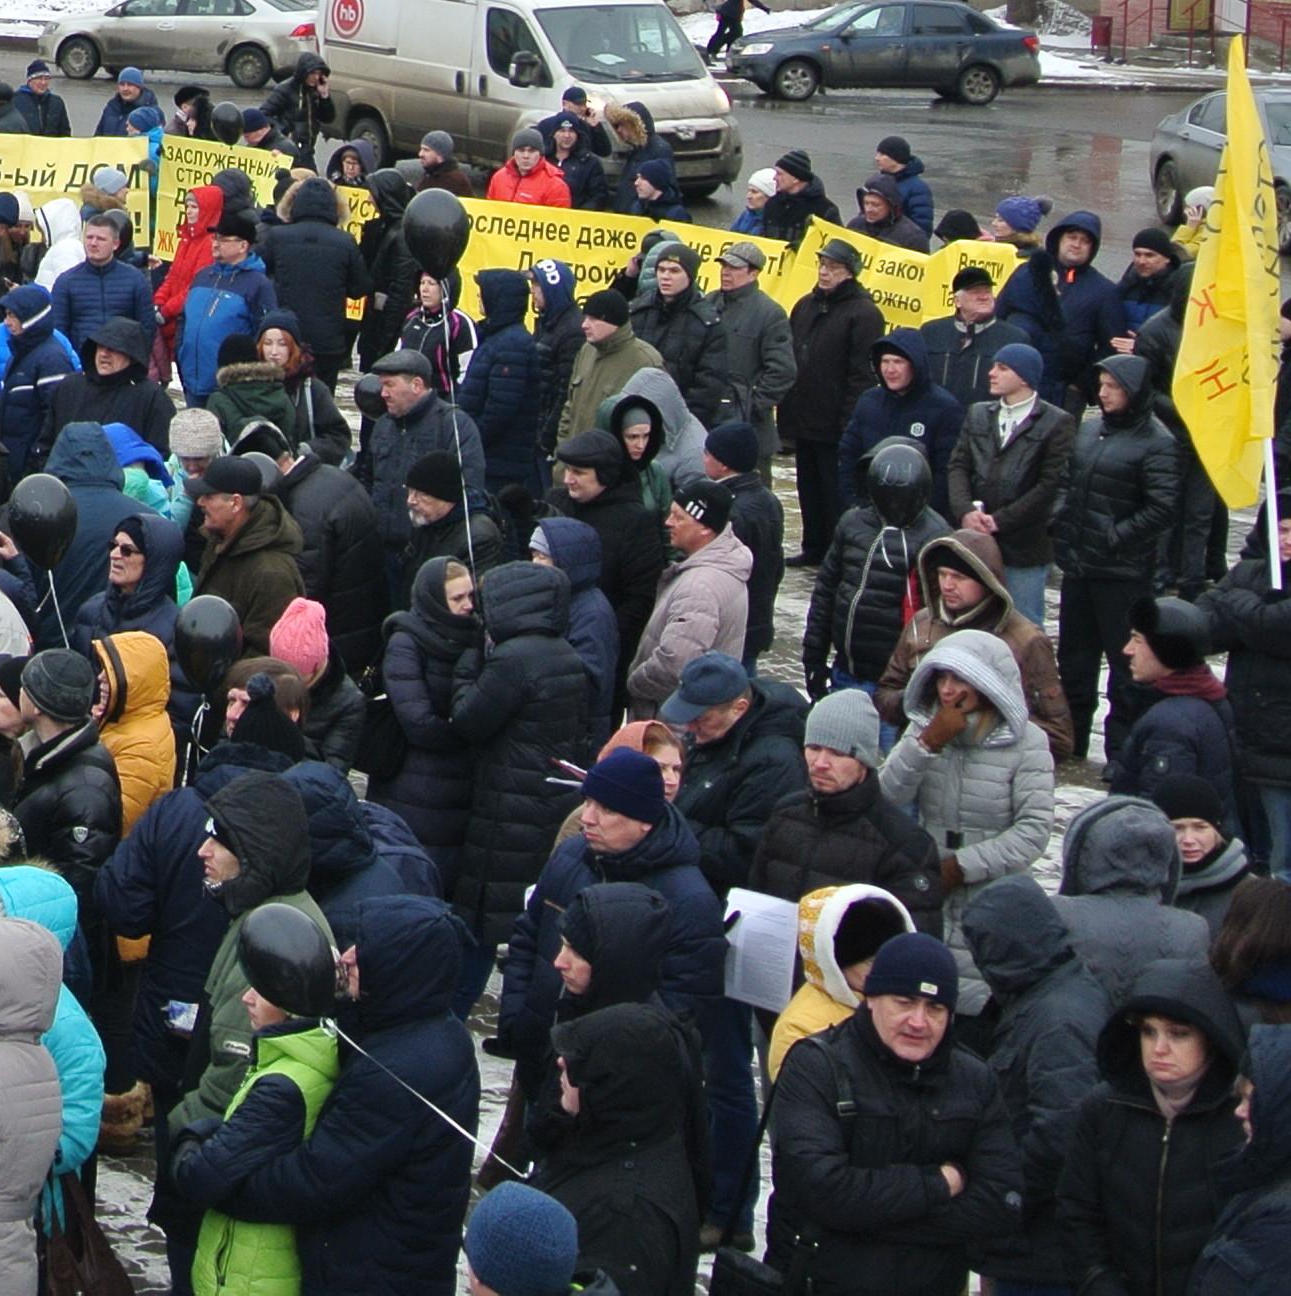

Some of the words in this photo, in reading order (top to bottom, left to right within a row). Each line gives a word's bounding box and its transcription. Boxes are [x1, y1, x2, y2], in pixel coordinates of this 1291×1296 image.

[340, 3, 356, 21] hb
[167, 146, 280, 179] ЗАСЛУЖЕННЫЙ
[158, 230, 174, 254] ЖК
[468, 214, 571, 243] оследнее
[576, 226, 637, 251] даже
[869, 288, 921, 313] ожно
